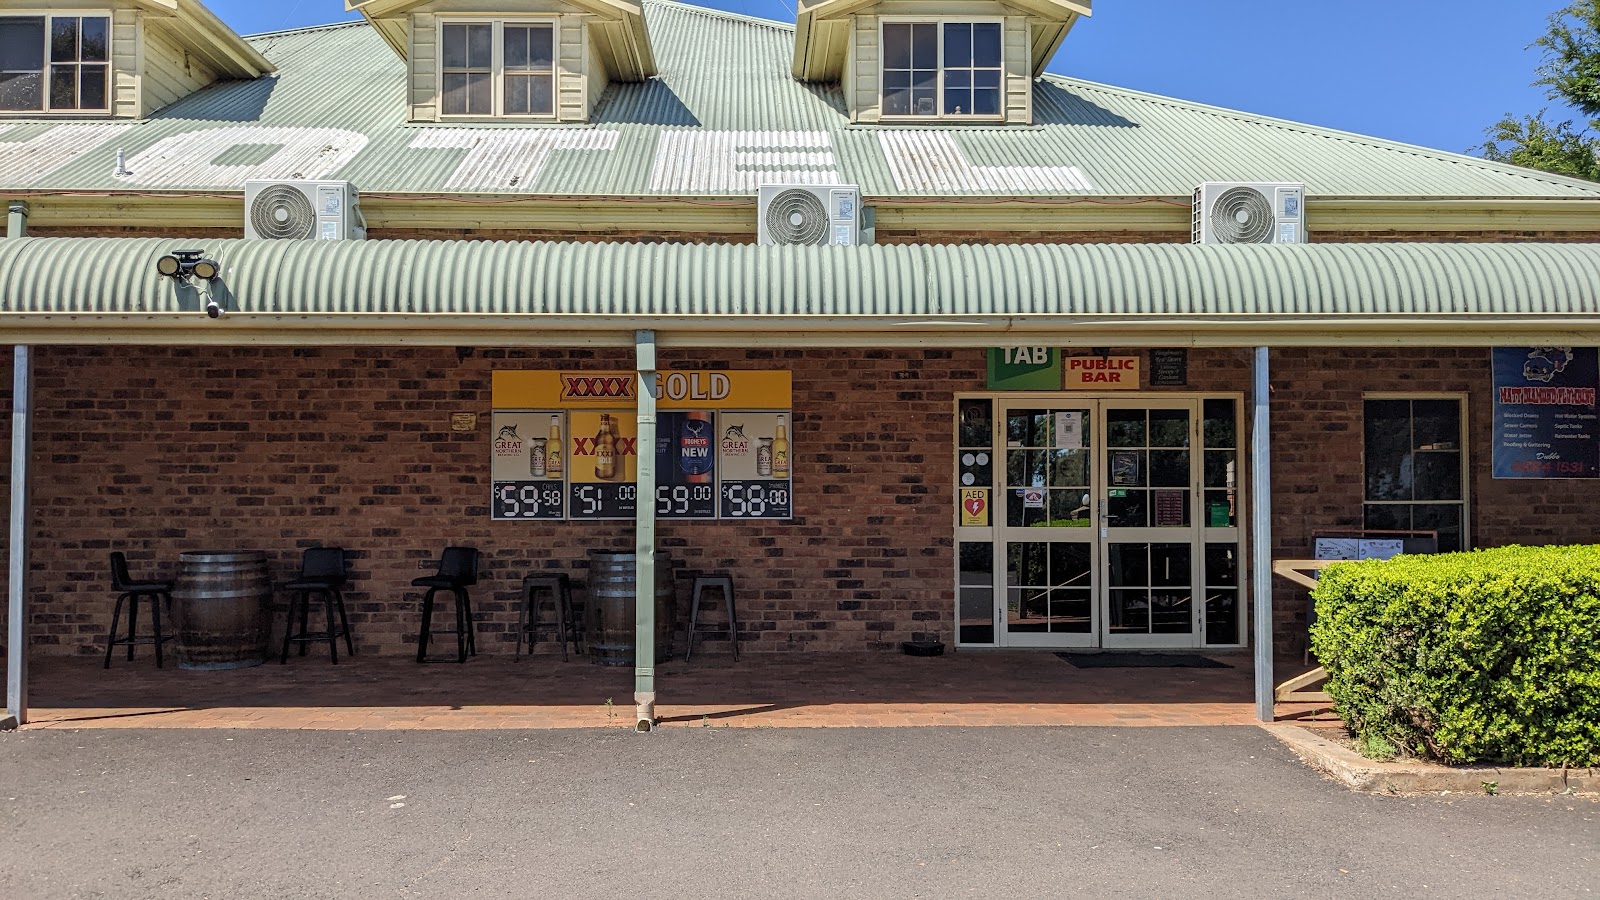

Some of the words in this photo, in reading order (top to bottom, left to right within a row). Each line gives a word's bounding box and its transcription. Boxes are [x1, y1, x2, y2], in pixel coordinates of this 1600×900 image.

[1001, 347, 1048, 365] TAB
[1070, 359, 1135, 370] PUBLIC
[1081, 372, 1122, 383] BAR
[566, 377, 631, 397] XXXX
[1499, 386, 1522, 404] MATT
[494, 441, 522, 449] GREAT
[722, 441, 749, 449] GREAT
[1503, 441, 1523, 449] Roofing
[681, 448, 709, 458] NEW
[1536, 451, 1561, 460] Dubbo
[965, 490, 985, 499] AED
